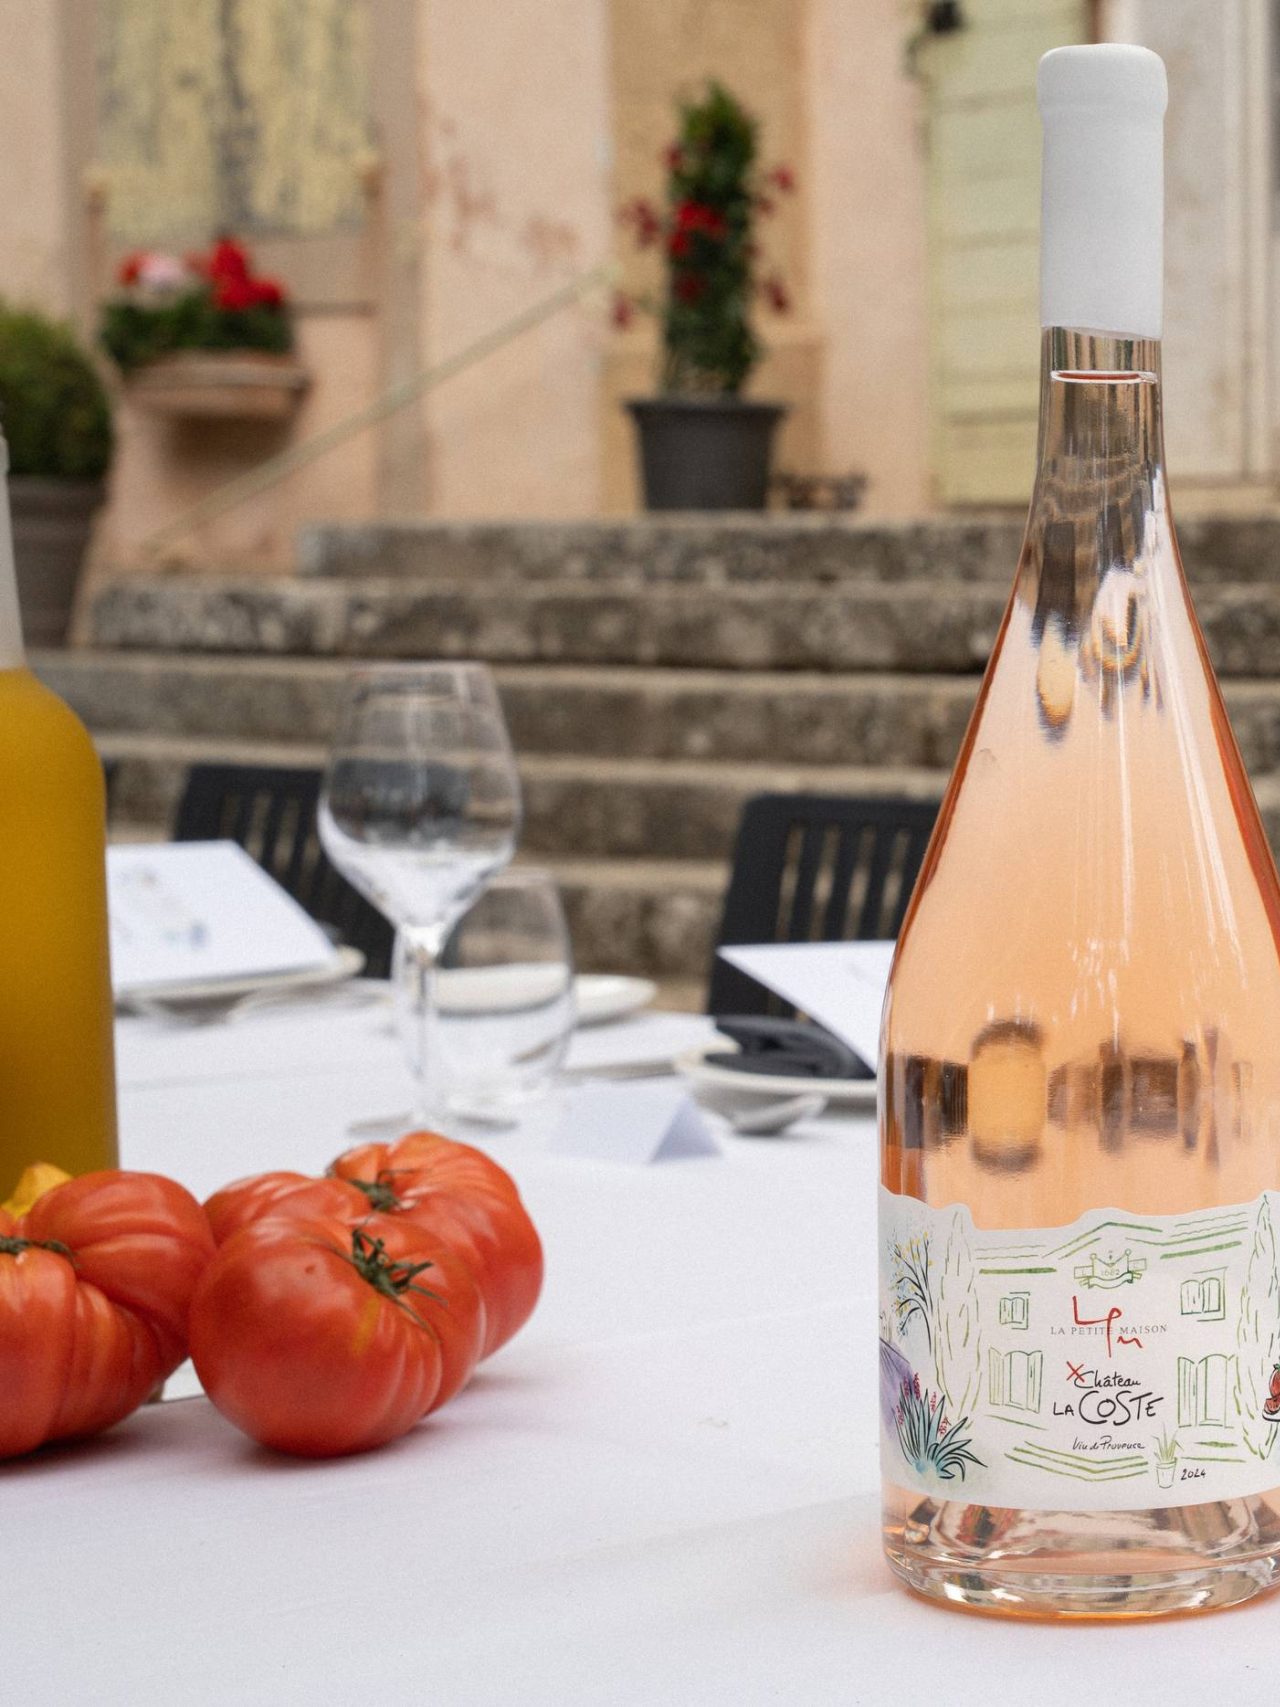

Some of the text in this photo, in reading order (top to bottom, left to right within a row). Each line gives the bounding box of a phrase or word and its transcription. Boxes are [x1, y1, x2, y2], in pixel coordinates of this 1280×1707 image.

[1050, 1326, 1066, 1335] LA
[1119, 1324, 1168, 1335] MAISON
[1074, 1369, 1141, 1389] Château
[1053, 1390, 1164, 1426] LA COSTE
[1072, 1437, 1088, 1450] Vin
[1099, 1435, 1145, 1450] Provence
[1181, 1468, 1207, 1481] 2024
